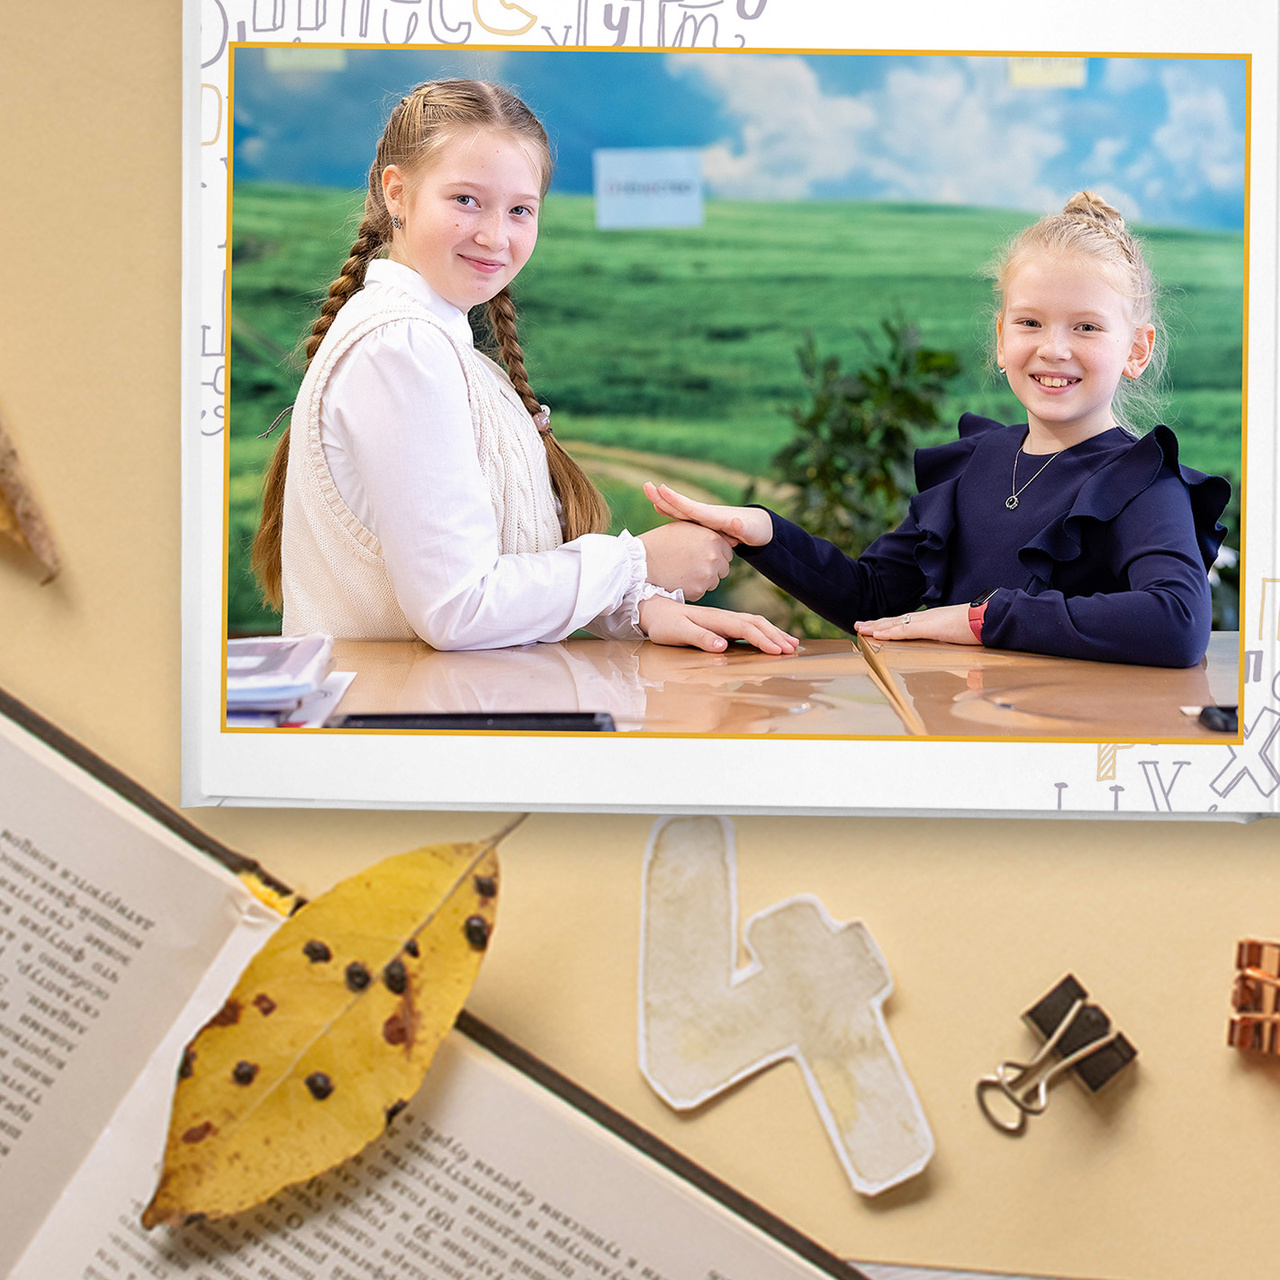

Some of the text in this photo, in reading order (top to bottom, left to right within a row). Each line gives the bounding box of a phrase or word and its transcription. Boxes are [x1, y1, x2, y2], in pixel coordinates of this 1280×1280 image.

[0, 828, 156, 932] датируются концом
[17, 914, 120, 985] что фигурки
[37, 951, 110, 1001] особенно
[472, 1159, 536, 1207] берегам
